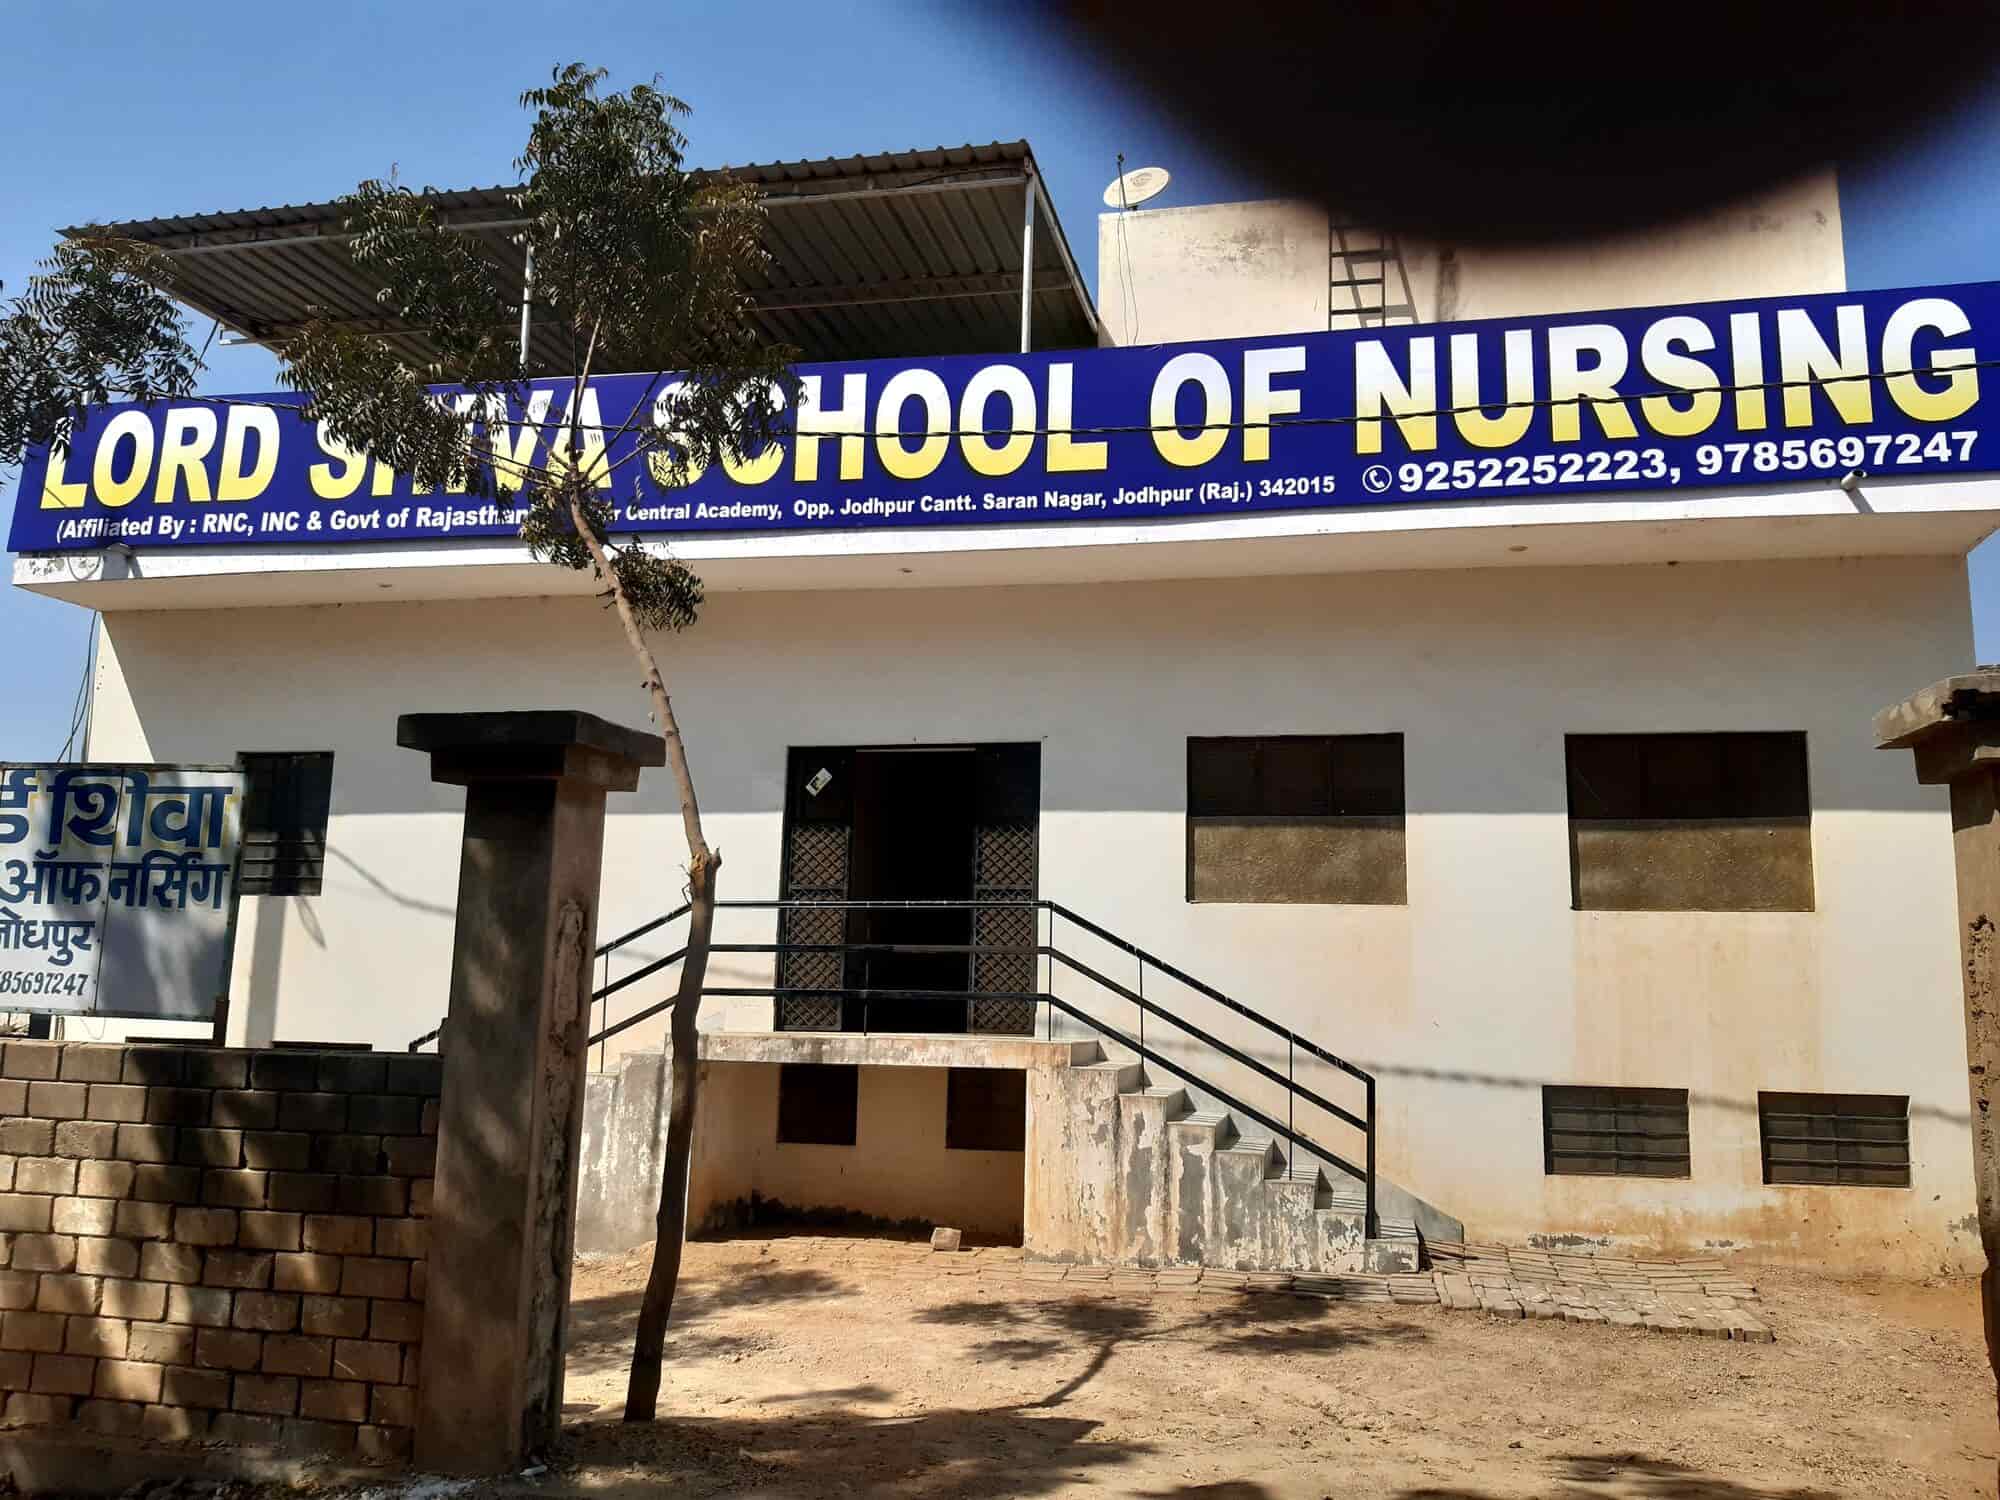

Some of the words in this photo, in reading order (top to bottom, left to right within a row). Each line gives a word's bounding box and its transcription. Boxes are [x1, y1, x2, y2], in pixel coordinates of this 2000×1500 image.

[40, 404, 280, 509] LORD
[1150, 346, 1307, 469] OF
[1355, 297, 1981, 456] NURSING
[1398, 448, 1682, 494] 9252252223,
[1696, 430, 1979, 476] 9785697247
[56, 516, 153, 544] (Affiliated
[158, 515, 185, 539] By
[202, 512, 254, 537] RNC,
[261, 510, 300, 532] INC
[306, 510, 322, 530] &
[330, 507, 380, 530] Govt
[387, 507, 410, 528] of
[626, 503, 690, 522] Central
[695, 501, 783, 521] Academy,
[793, 499, 835, 519] Opp.
[840, 497, 915, 518] Jodhpur
[920, 494, 977, 513] Cantt.
[983, 491, 1038, 511] Saran
[1044, 489, 1107, 512] Nagar,
[1113, 485, 1194, 508] Jodhpur
[1199, 481, 1252, 505] (Raj.)
[1259, 475, 1336, 498] 342015
[0, 970, 89, 996] 85697247
